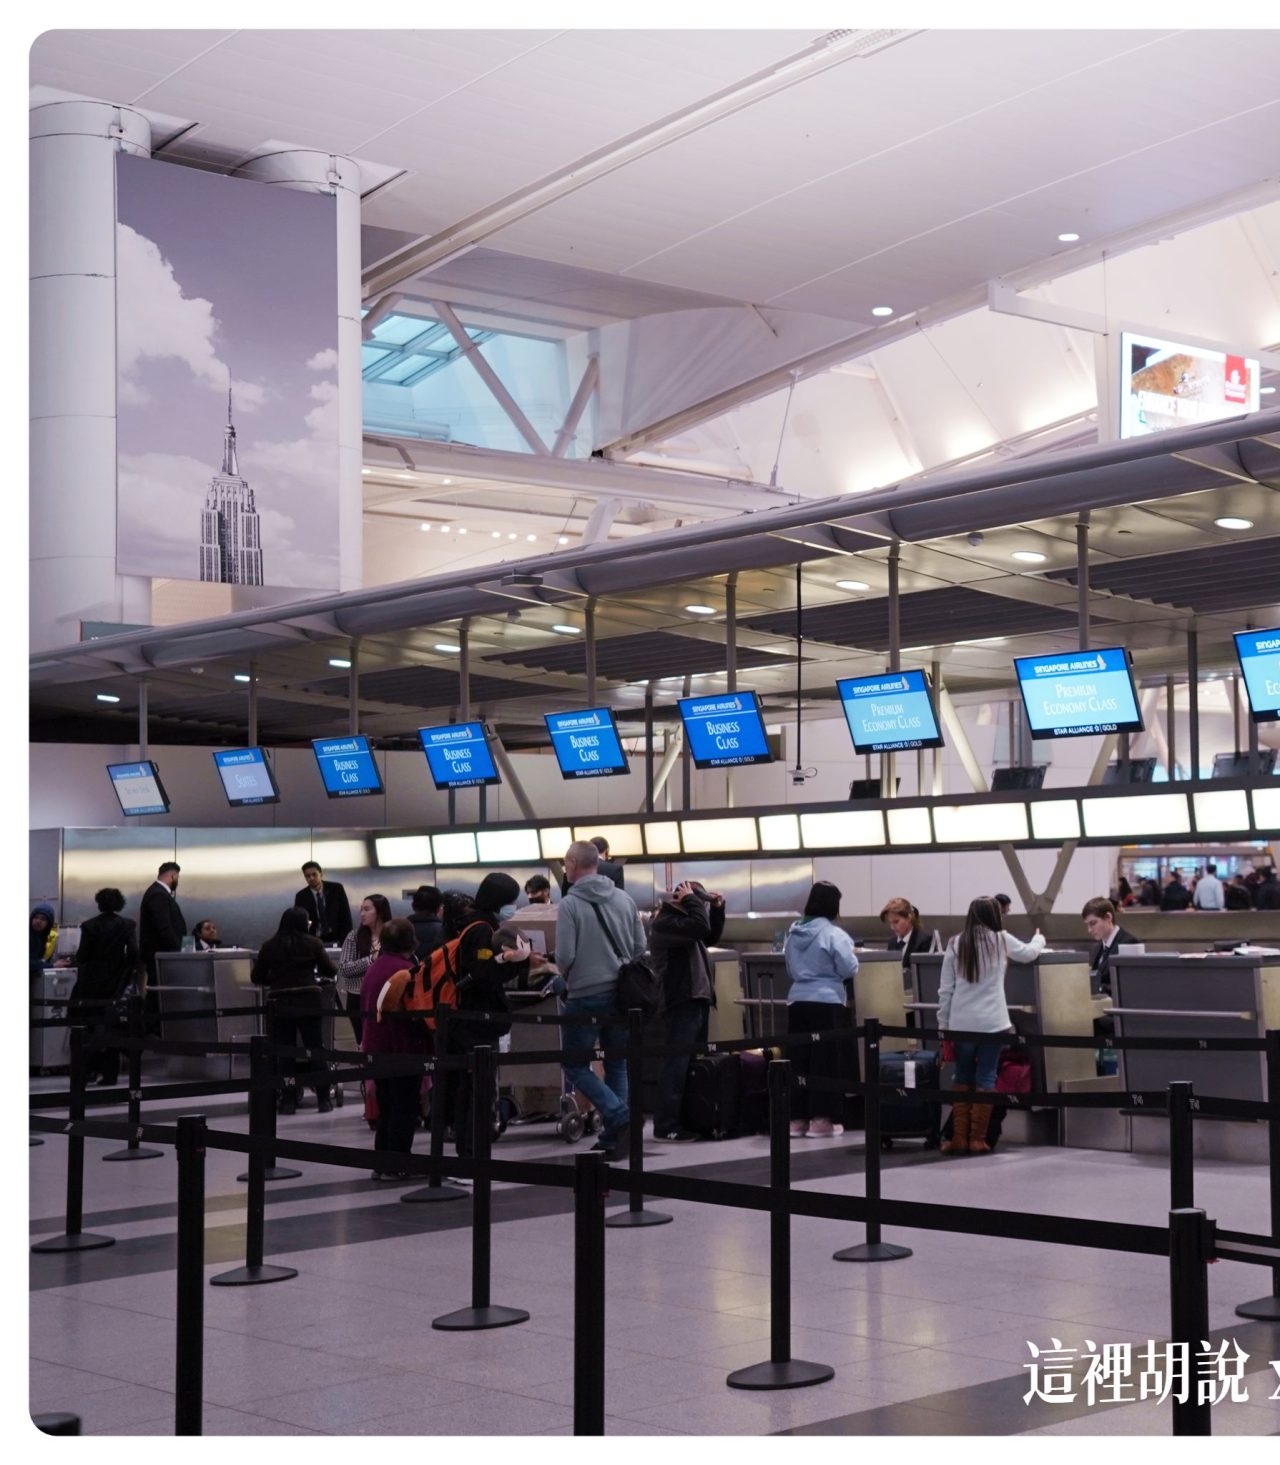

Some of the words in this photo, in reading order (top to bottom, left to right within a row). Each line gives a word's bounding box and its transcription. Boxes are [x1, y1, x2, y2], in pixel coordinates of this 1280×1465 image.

[1034, 662, 1069, 674] SINGAPORE
[1055, 684, 1097, 699] PREMIUM
[1043, 700, 1086, 716] ECONOMY
[1088, 696, 1118, 712] CLASS
[706, 721, 740, 735] BUSINESS
[570, 735, 599, 749] BUSINESS
[716, 736, 739, 750] CLASS
[579, 749, 599, 762] CLASS
[452, 761, 472, 773] CLASS
